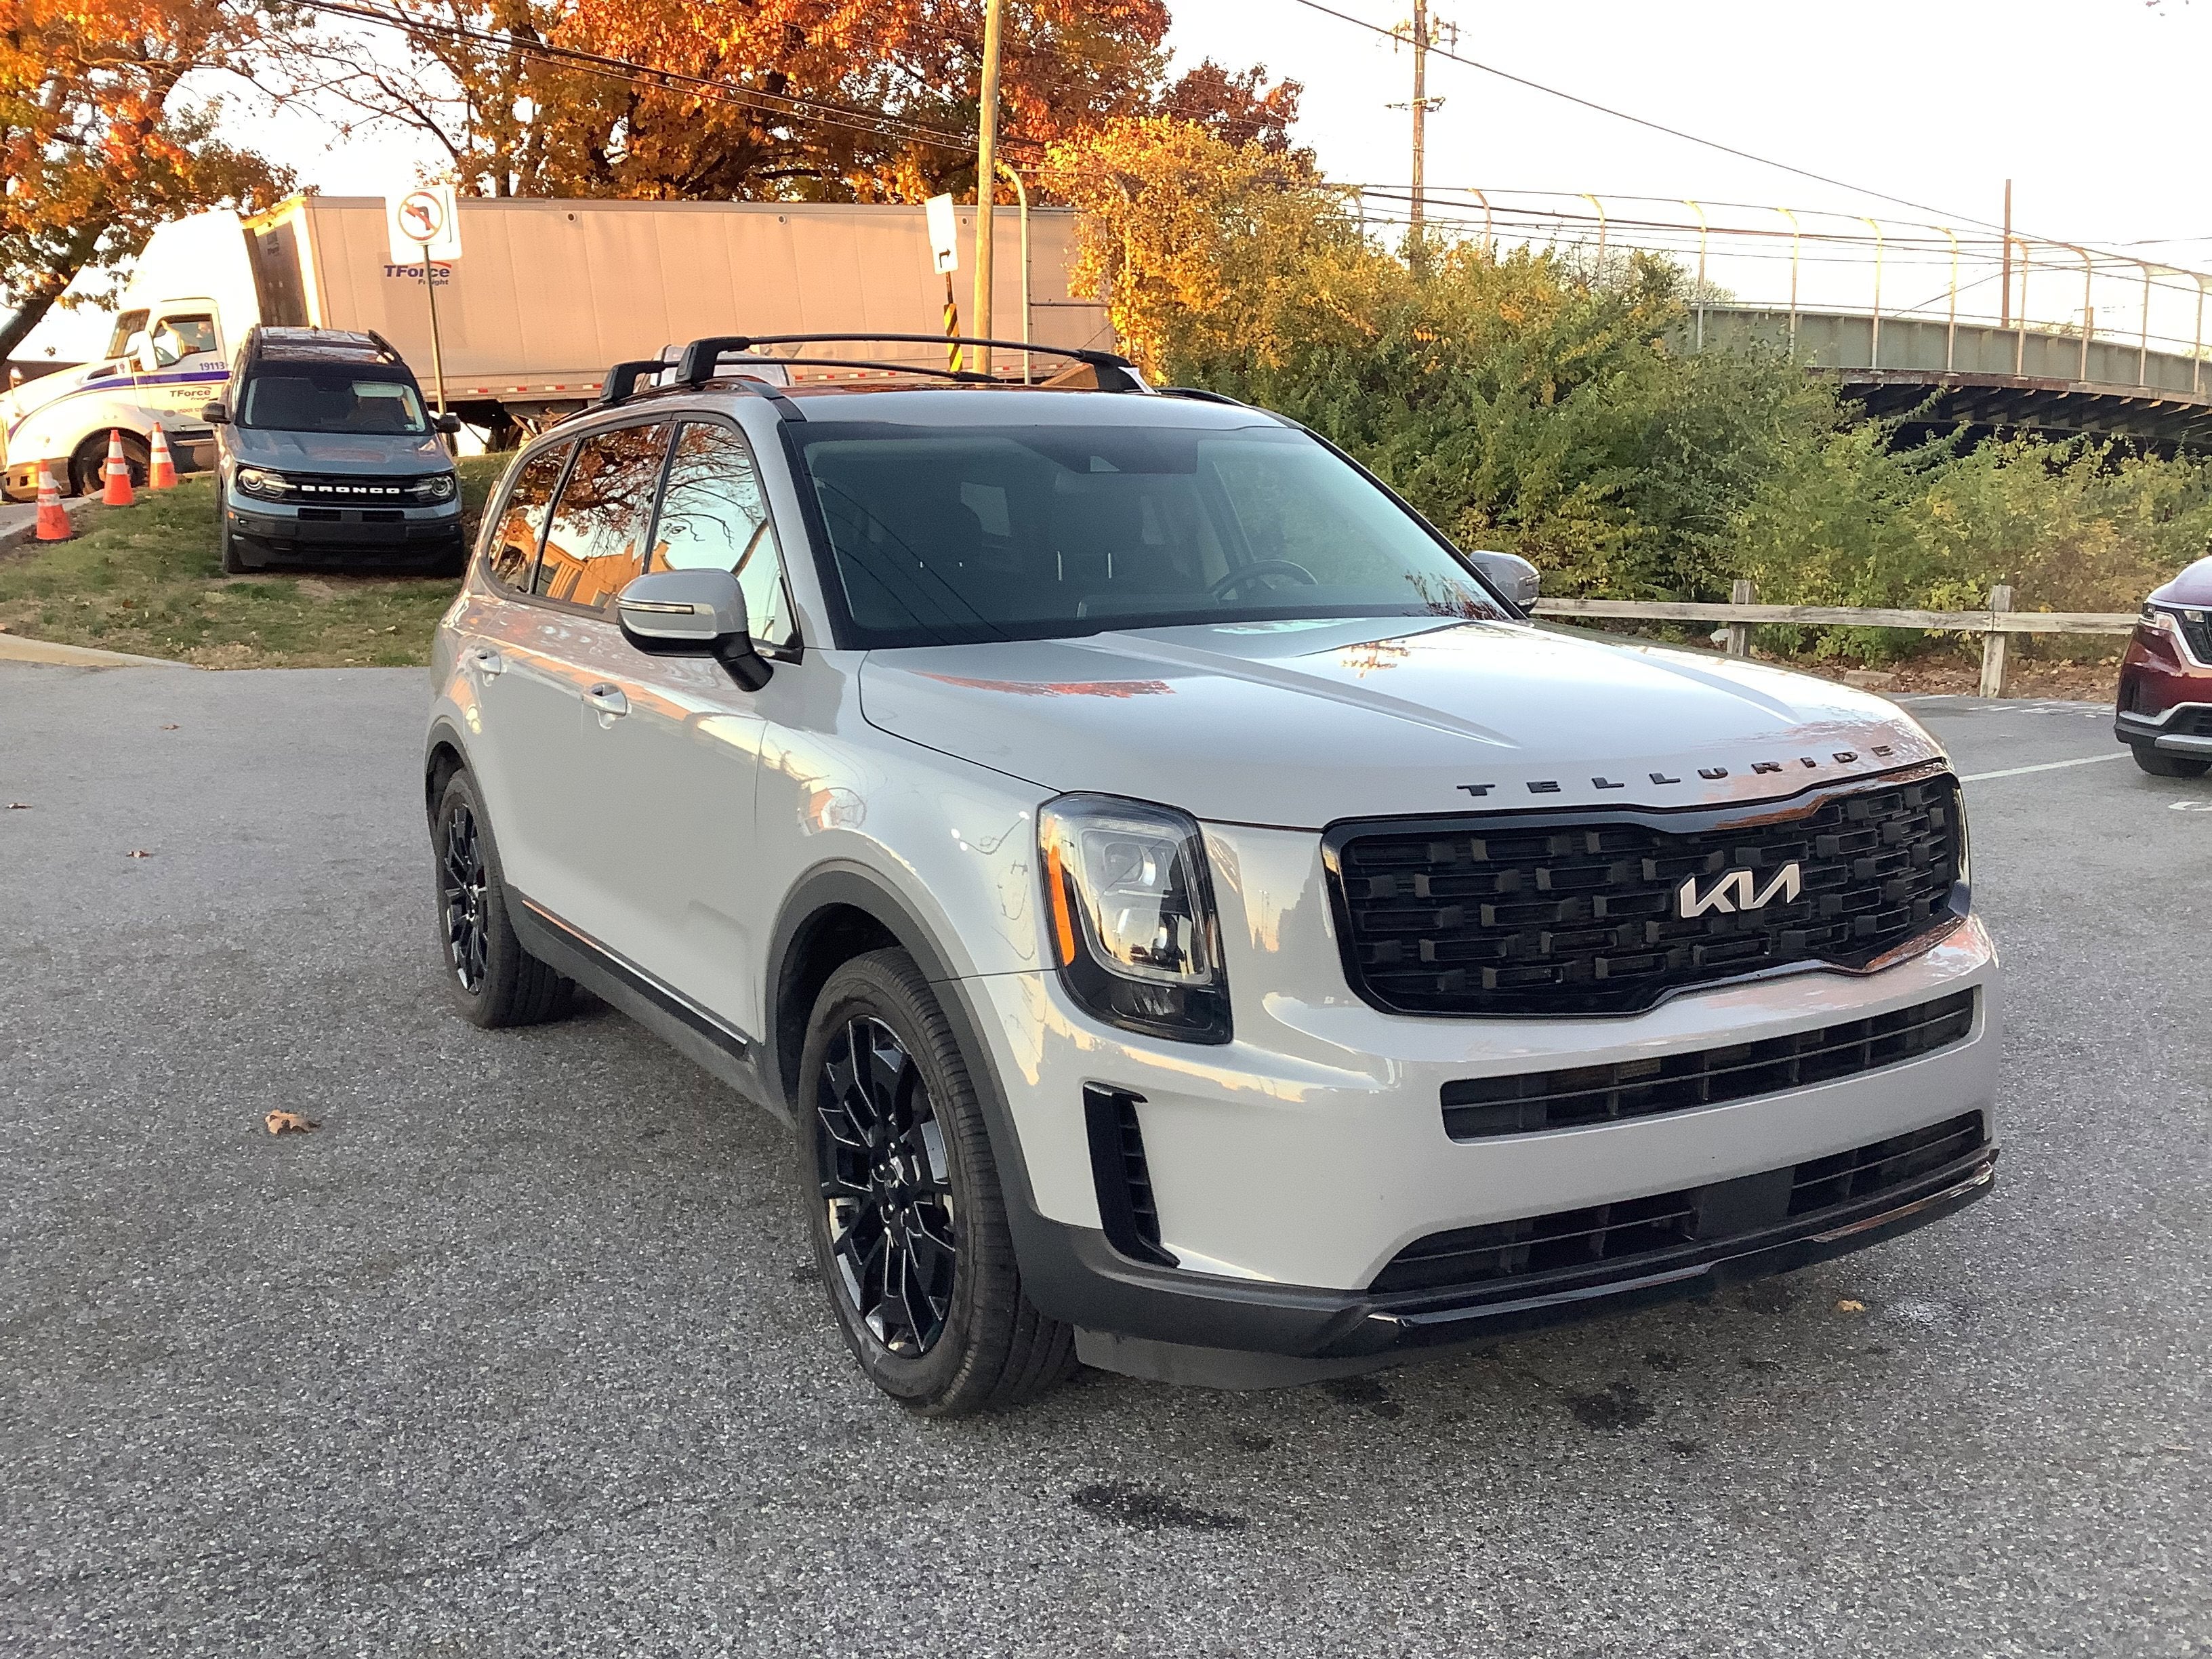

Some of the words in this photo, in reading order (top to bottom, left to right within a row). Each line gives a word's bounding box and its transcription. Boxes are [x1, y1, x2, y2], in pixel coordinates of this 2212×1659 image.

[199, 361, 225, 371] 19113
[302, 485, 400, 494] BRONCO
[1456, 745, 1894, 796] TELLURIDE
[1679, 863, 1801, 918] KIA
